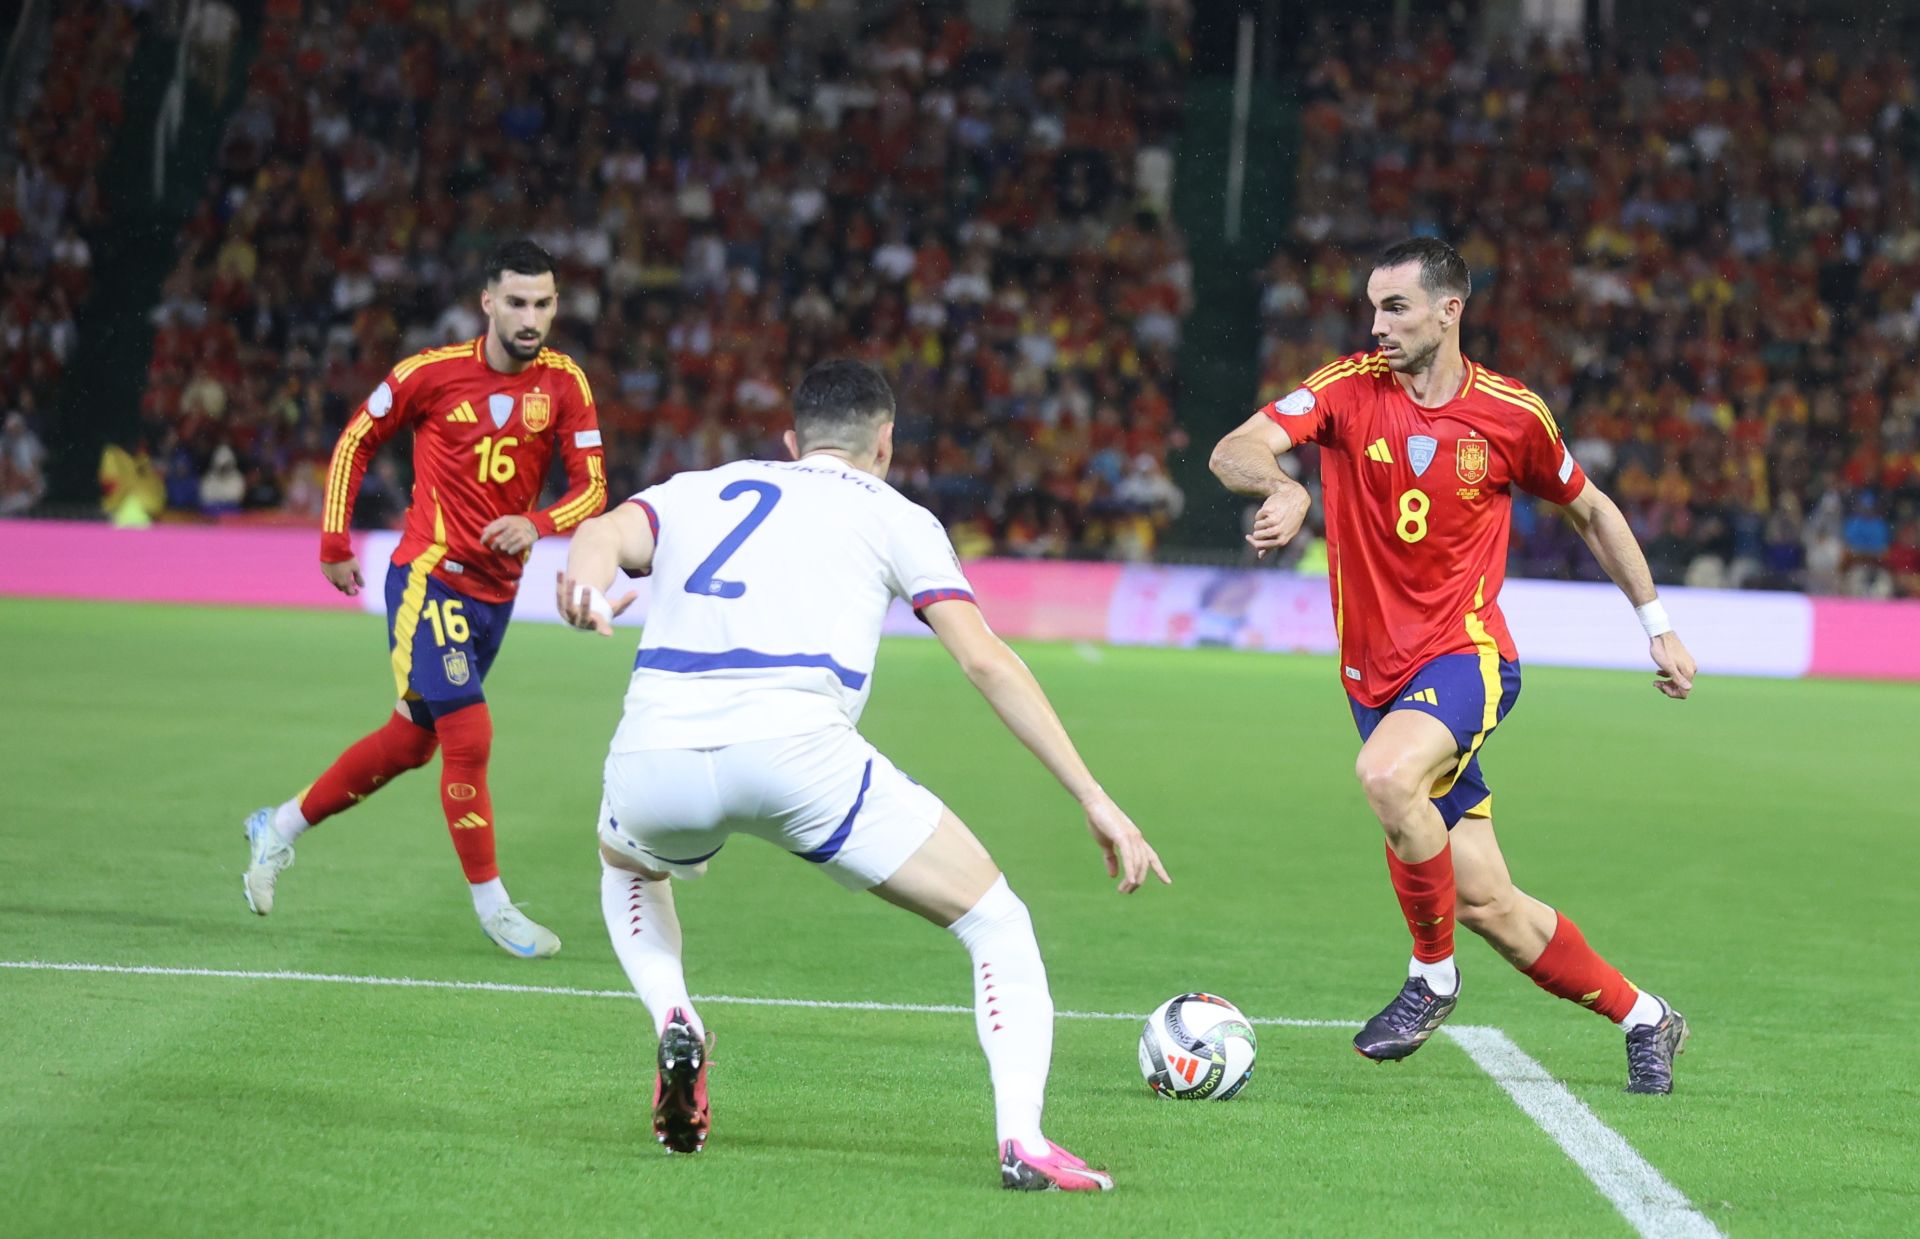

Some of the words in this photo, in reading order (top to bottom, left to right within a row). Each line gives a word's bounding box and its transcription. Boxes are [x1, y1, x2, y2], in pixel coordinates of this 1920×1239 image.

[473, 435, 519, 484] 16
[683, 478, 783, 600] 2
[1395, 488, 1431, 544] 8
[422, 599, 471, 648] 16
[1167, 1006, 1191, 1045] NATIONS
